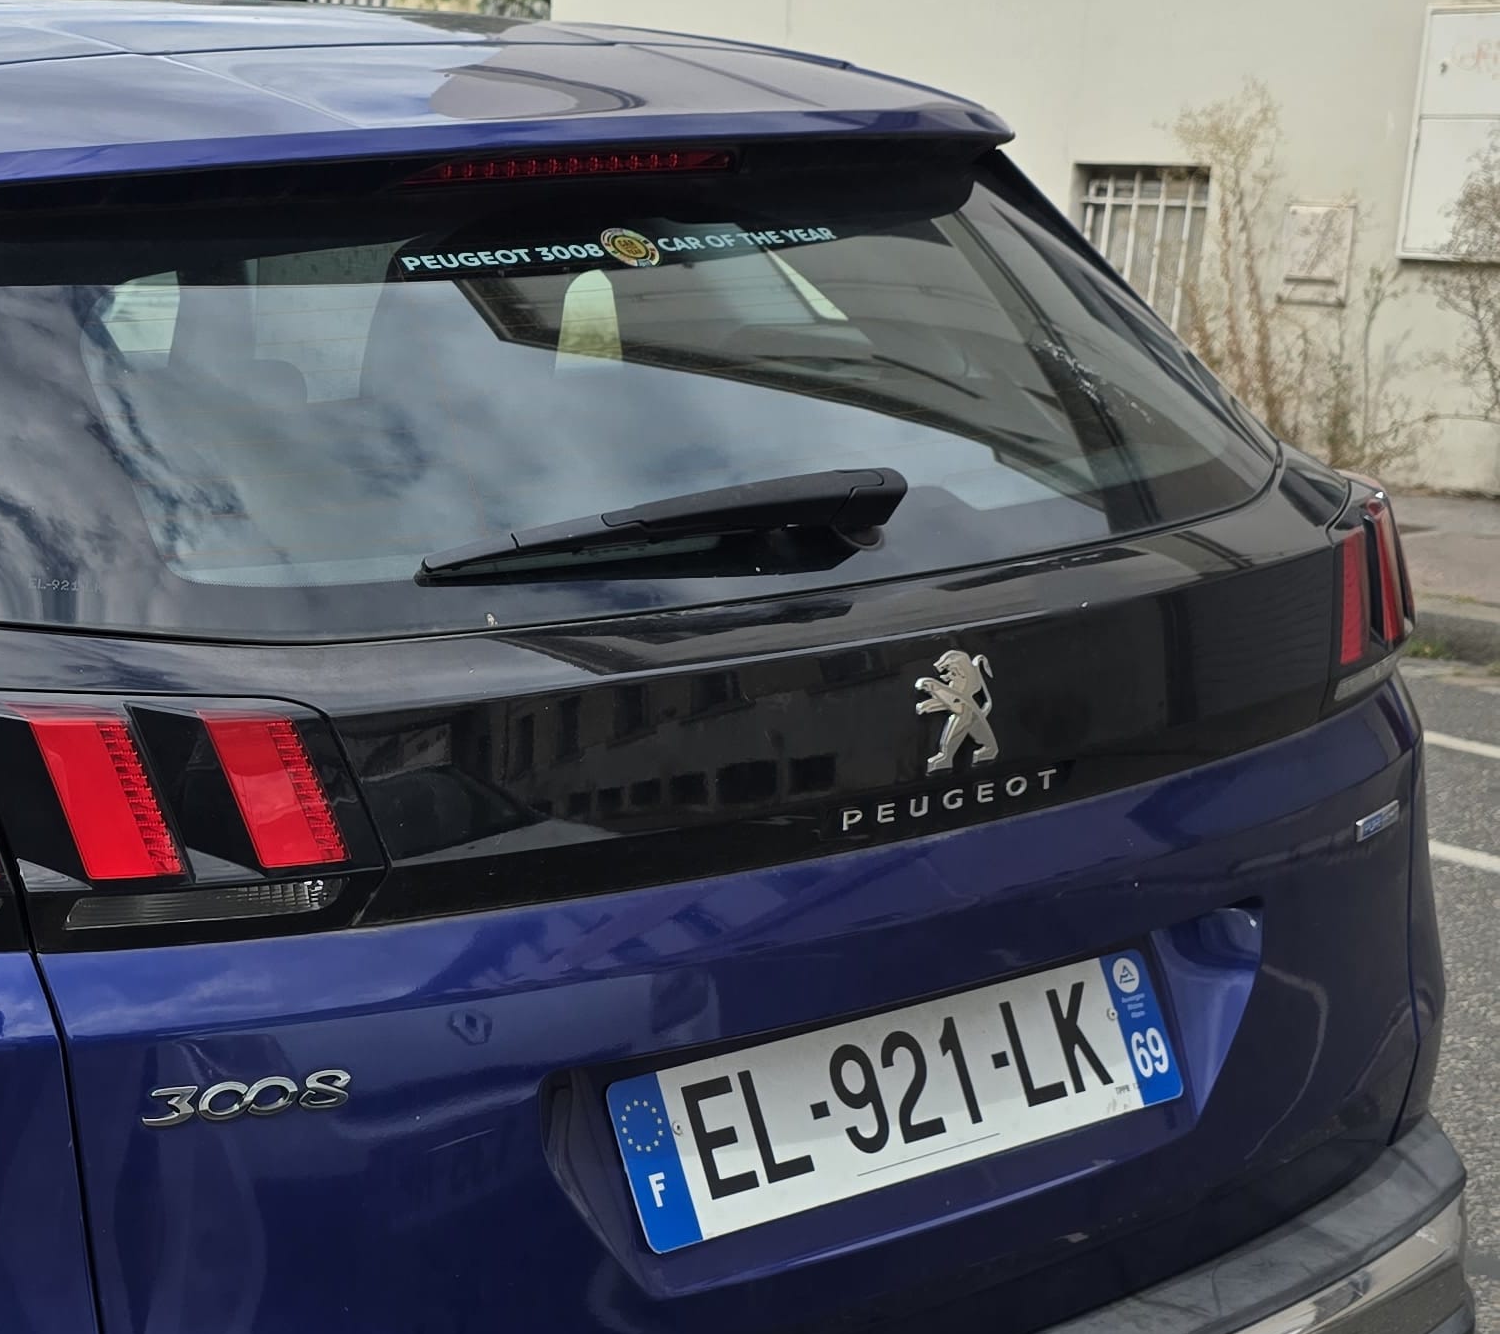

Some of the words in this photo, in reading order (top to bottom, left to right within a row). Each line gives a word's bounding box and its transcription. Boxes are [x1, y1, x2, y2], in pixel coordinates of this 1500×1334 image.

[401, 249, 532, 271] PEUGEOT
[535, 243, 605, 262] 3008
[656, 237, 704, 252] CAR
[705, 233, 742, 249] OF
[739, 230, 782, 245] THE
[780, 227, 837, 242] YEAR
[841, 768, 1058, 832] PEUGEOT
[1131, 1027, 1170, 1079] 69
[141, 1069, 352, 1127] 3008
[681, 981, 1114, 1201] EL-921-LK
[648, 1171, 666, 1209] F
